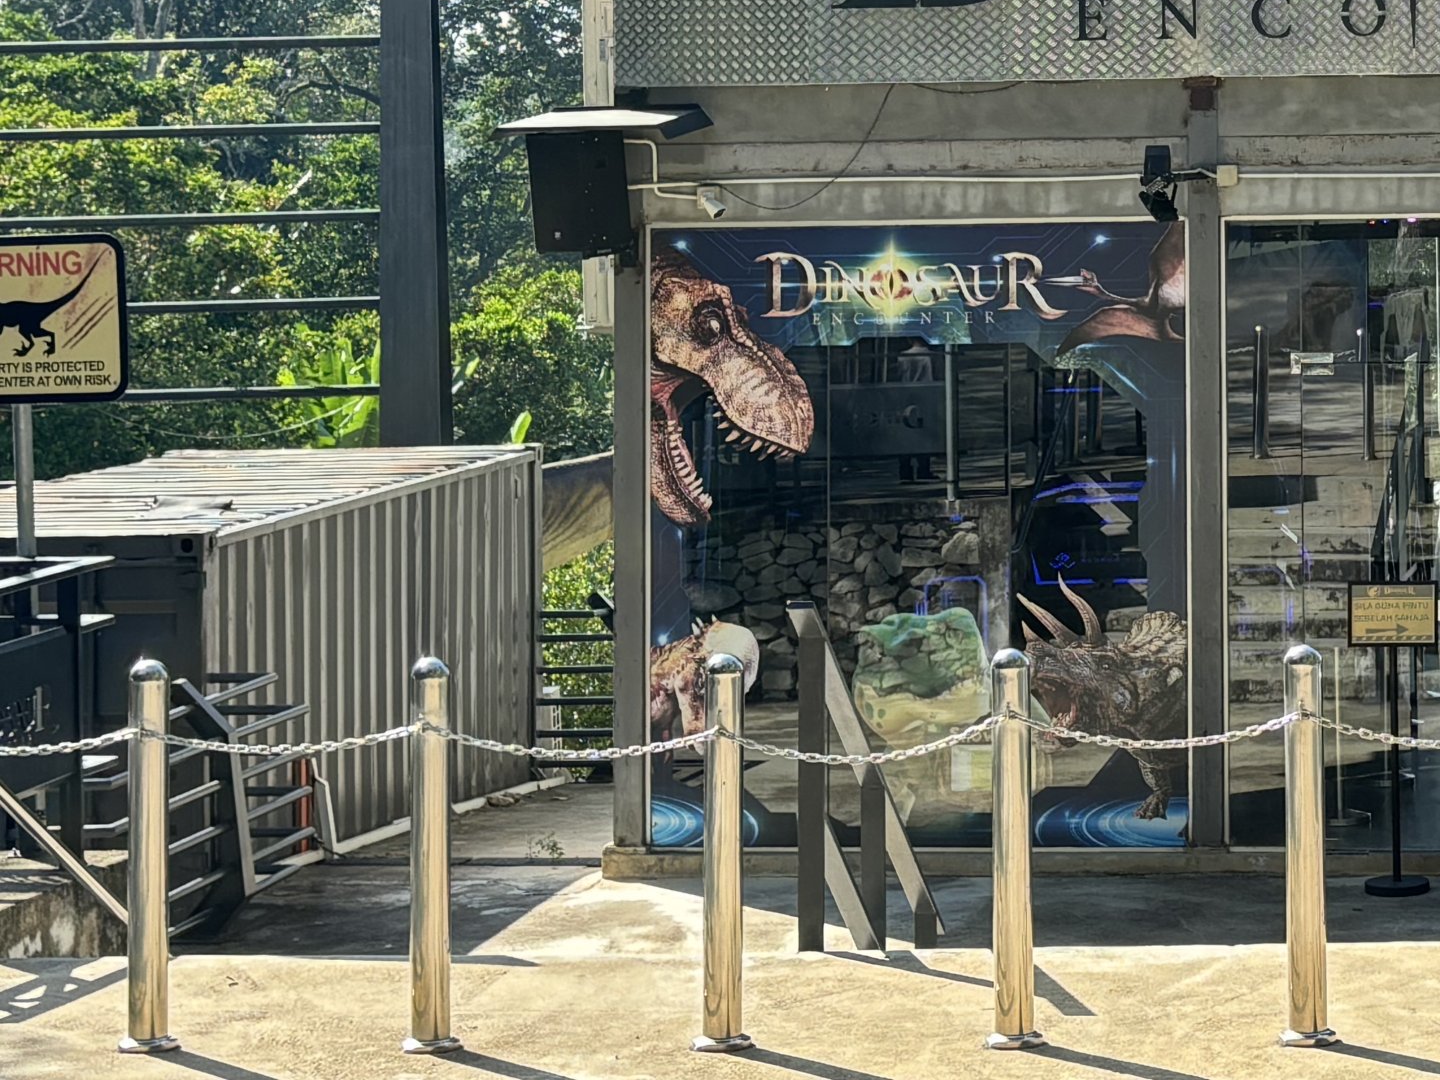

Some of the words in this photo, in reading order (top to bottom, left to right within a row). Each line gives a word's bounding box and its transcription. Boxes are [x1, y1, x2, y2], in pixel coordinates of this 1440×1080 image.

[754, 251, 1068, 320] DINOSAUR
[812, 310, 996, 326] ENCOUNTER
[22, 361, 32, 373] IS
[35, 360, 105, 373] PROTECTED
[37, 376, 50, 387] AT
[53, 375, 82, 387] OWN
